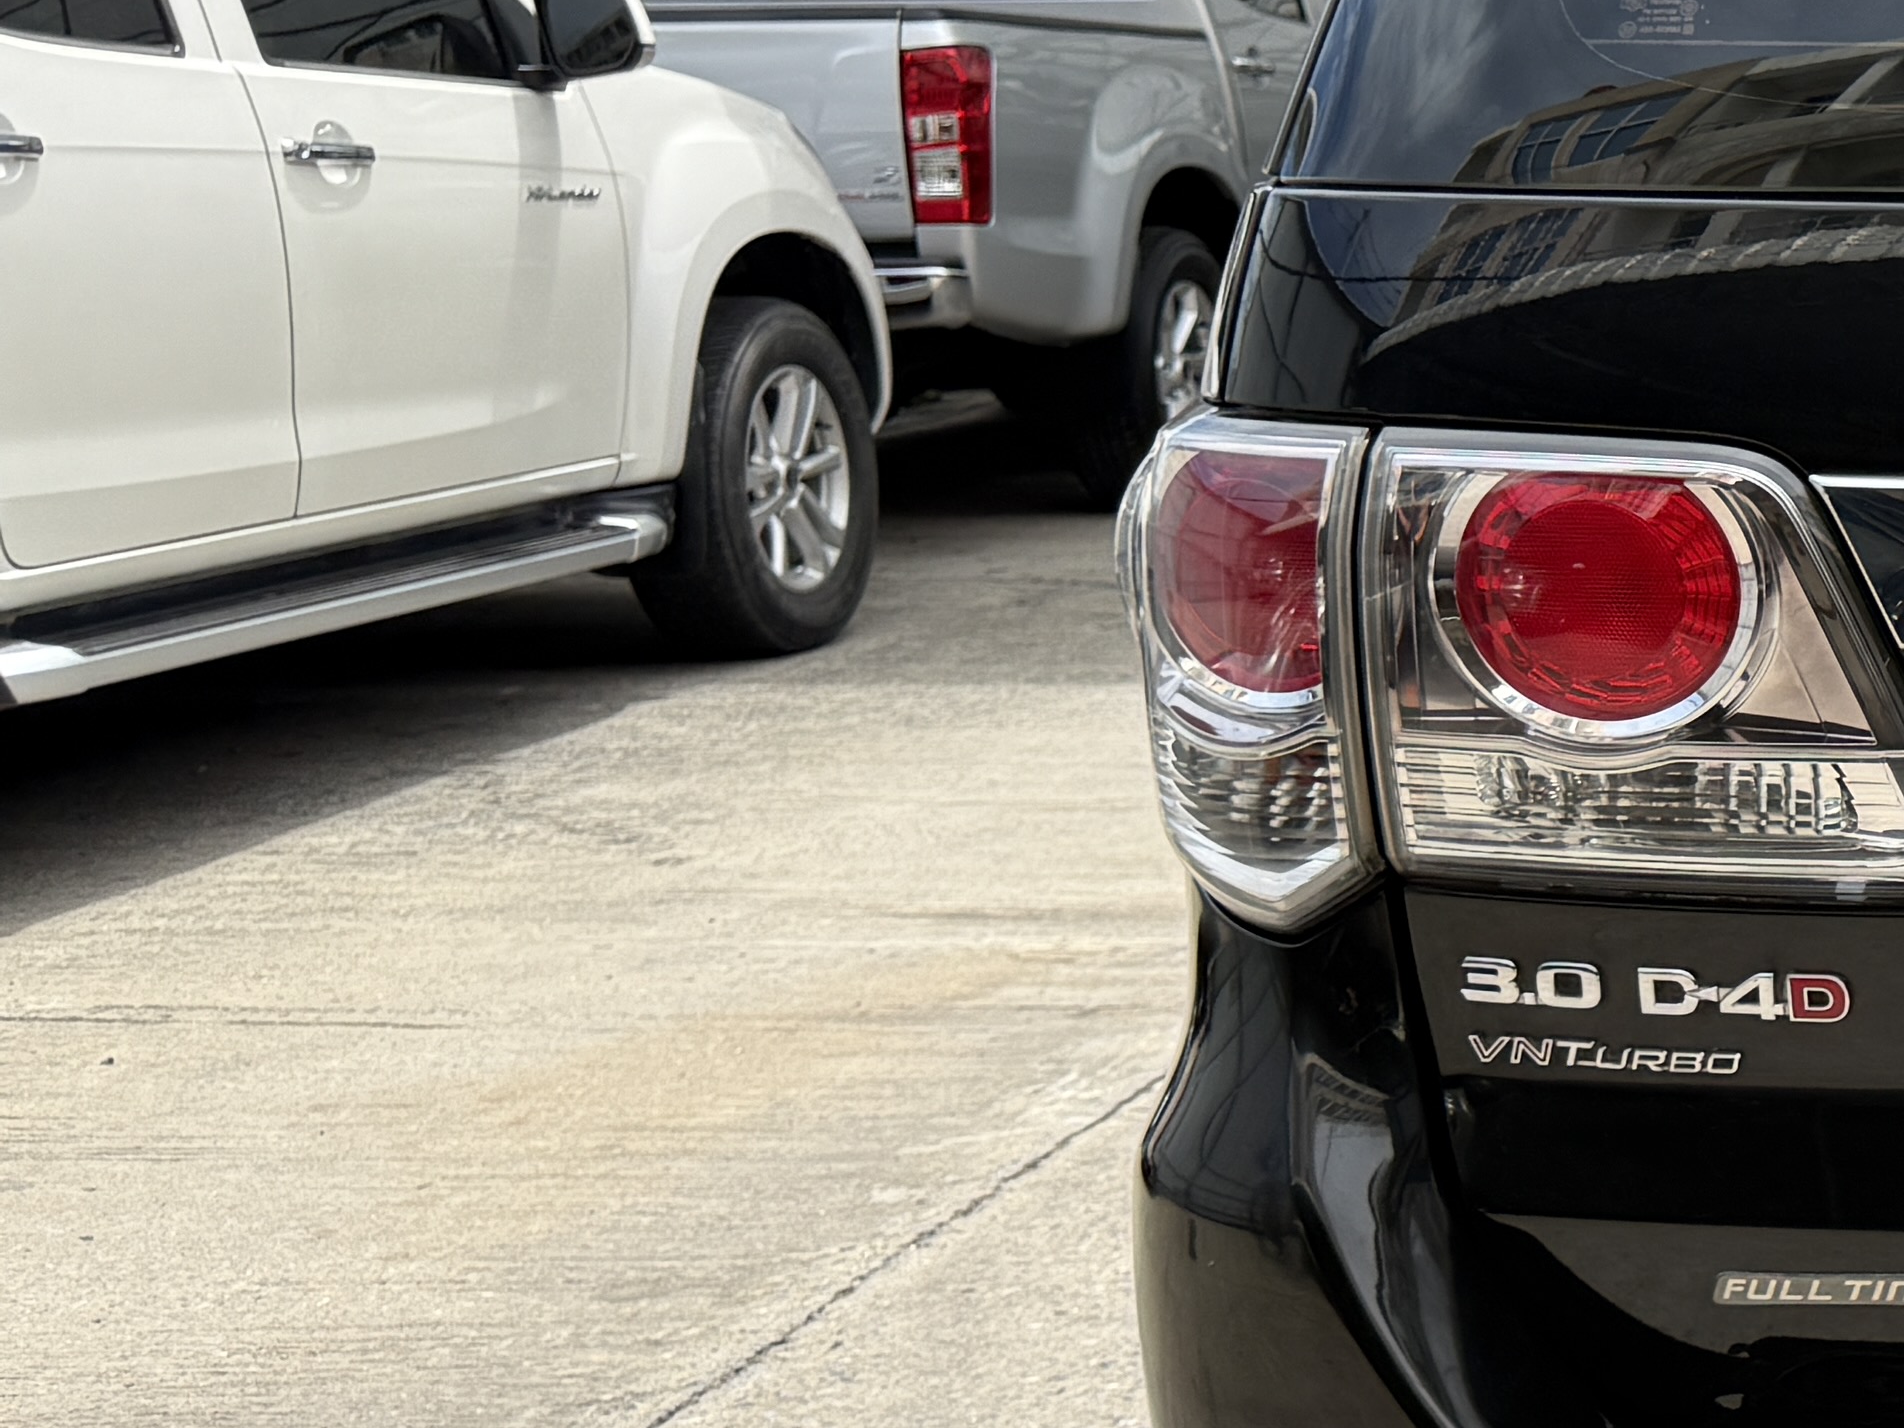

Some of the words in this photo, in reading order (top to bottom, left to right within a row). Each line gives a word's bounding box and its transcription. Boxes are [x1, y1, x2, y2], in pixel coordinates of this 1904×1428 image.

[1461, 955, 1602, 1010] 3.0
[1636, 965, 1851, 1024] D-4D
[1722, 1277, 1833, 1302] FULL
